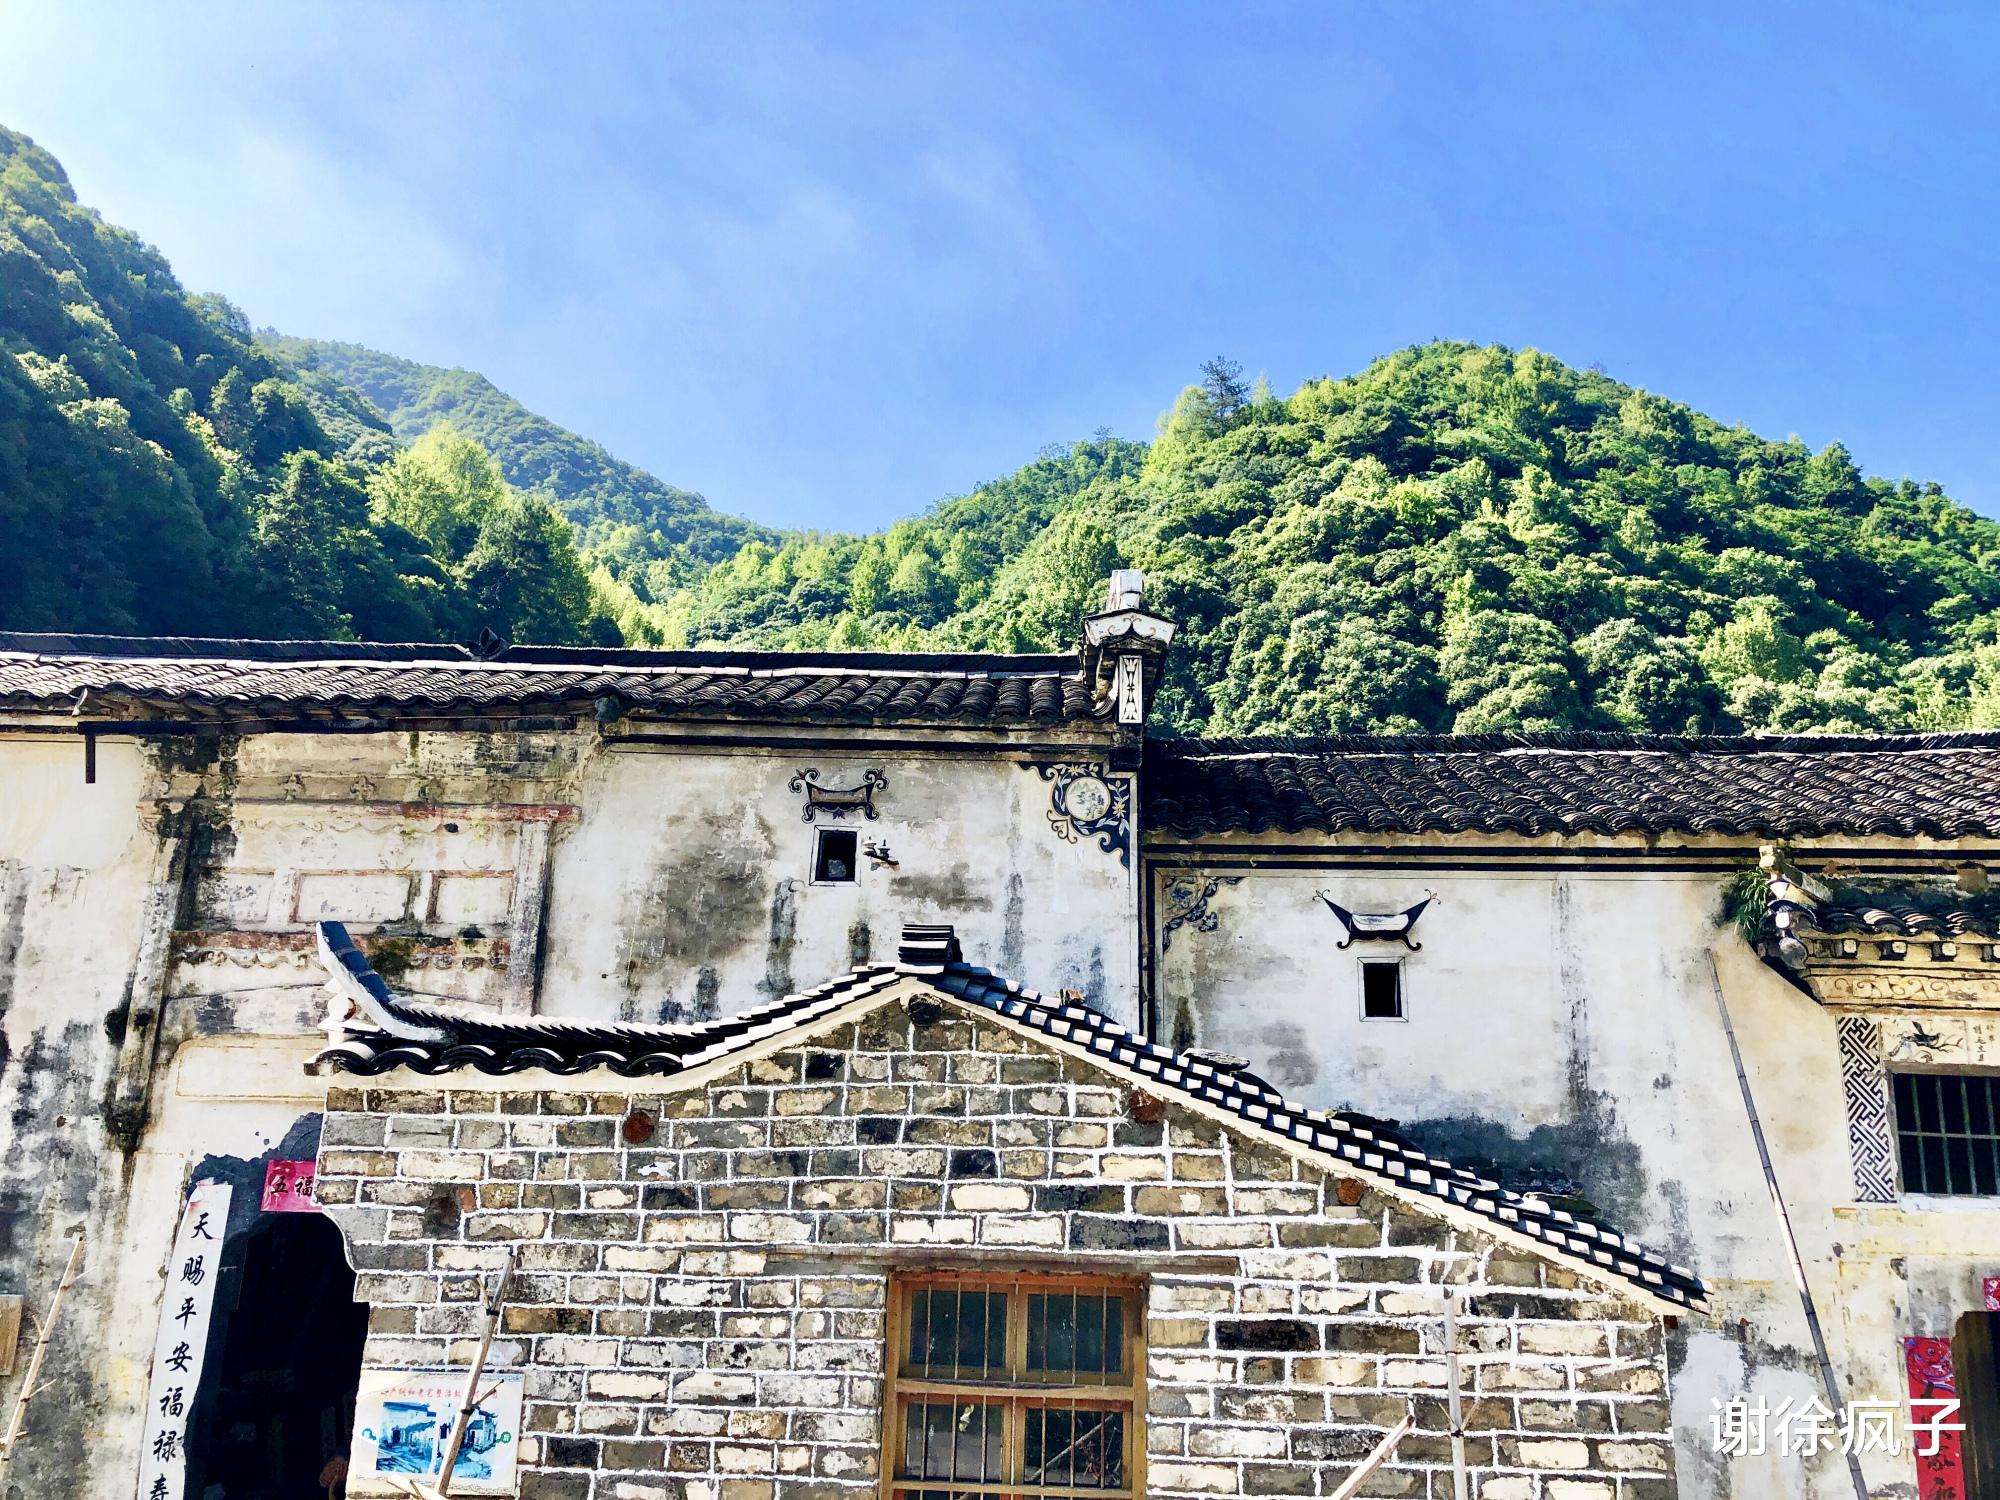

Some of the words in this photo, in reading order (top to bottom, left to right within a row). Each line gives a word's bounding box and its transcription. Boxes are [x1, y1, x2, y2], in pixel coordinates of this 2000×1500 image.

[270, 1175, 314, 1197] 五福
[149, 1211, 222, 1500] 天赐平安福禄寿
